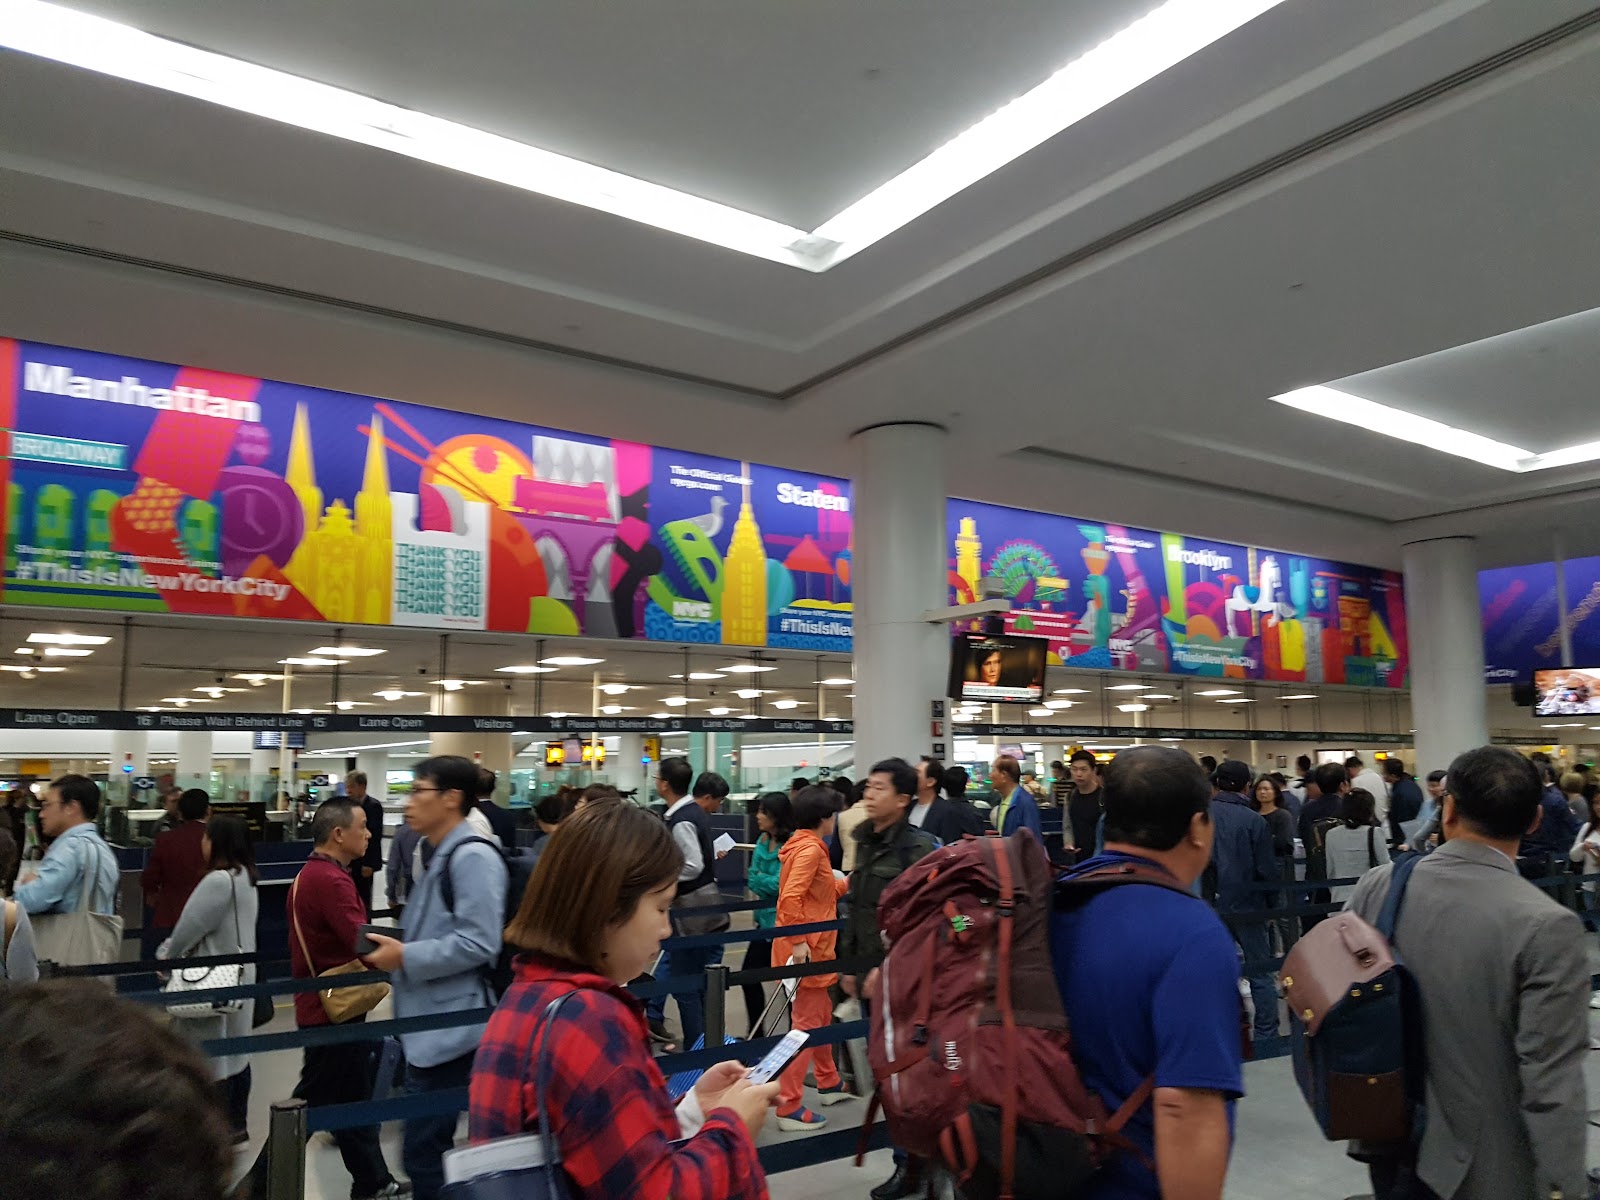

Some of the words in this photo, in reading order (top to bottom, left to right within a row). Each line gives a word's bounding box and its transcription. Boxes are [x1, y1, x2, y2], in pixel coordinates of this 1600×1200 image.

[24, 361, 262, 423] Manhattan
[776, 482, 850, 512] Staten
[1167, 544, 1233, 572] Brooklyn
[15, 561, 291, 600] #ThisIsNewYorkCity
[14, 711, 55, 724] Lane
[56, 711, 99, 726] Open
[136, 715, 154, 726] 16
[160, 715, 202, 726] Please
[205, 715, 233, 727] Wait
[235, 716, 275, 727] Behind
[278, 717, 304, 728] Line
[312, 718, 327, 729] 15
[359, 716, 389, 727] Lane
[391, 717, 424, 729] Open
[474, 718, 514, 729] Visitors
[567, 720, 597, 729] Please
[598, 719, 617, 729] Wait
[618, 720, 647, 729] Behind
[648, 720, 667, 729] Line
[702, 719, 723, 729] Lane
[724, 719, 746, 730] Open
[774, 721, 793, 730] Lane
[794, 721, 815, 731] Open
